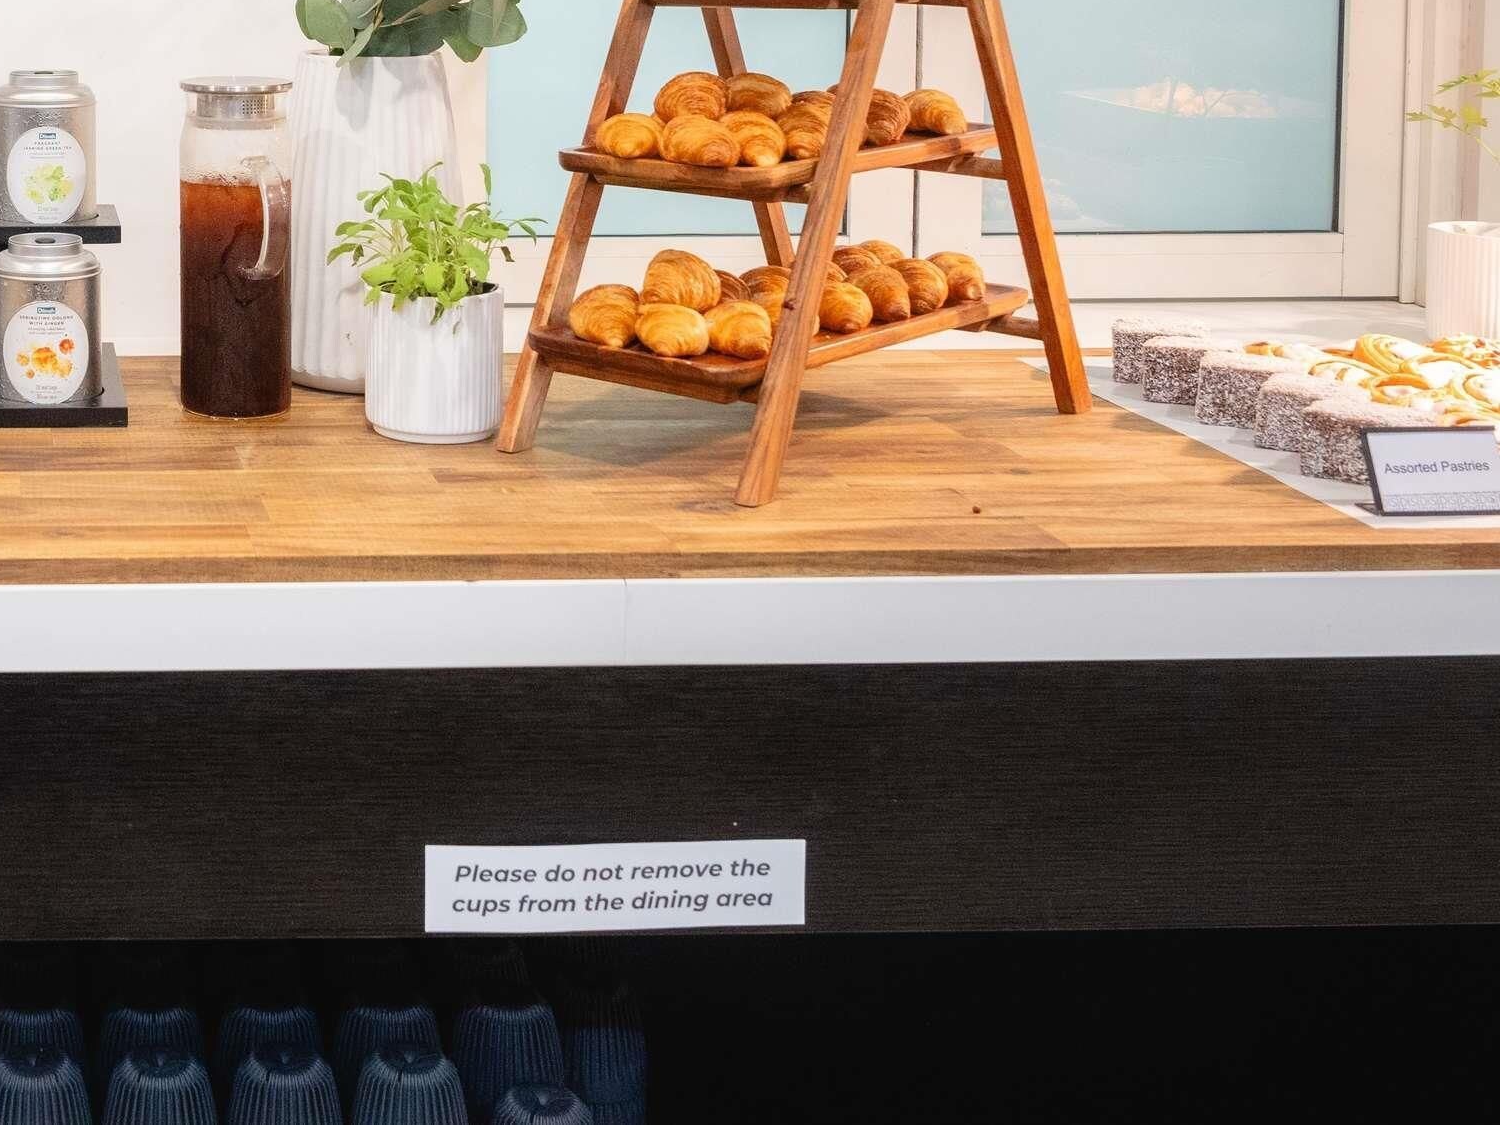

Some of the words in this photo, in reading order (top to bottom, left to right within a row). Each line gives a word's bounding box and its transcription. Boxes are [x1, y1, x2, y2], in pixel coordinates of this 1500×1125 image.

[1384, 462, 1438, 474] Assorted
[1441, 459, 1490, 472] Pastries
[454, 864, 537, 883] Please
[545, 864, 575, 882] do
[583, 863, 624, 881] not
[631, 860, 723, 880] remove
[730, 858, 771, 877] the
[452, 895, 510, 917] cups
[518, 894, 576, 913] from
[584, 893, 624, 911] the
[631, 890, 709, 912] dining
[716, 891, 773, 907] area
